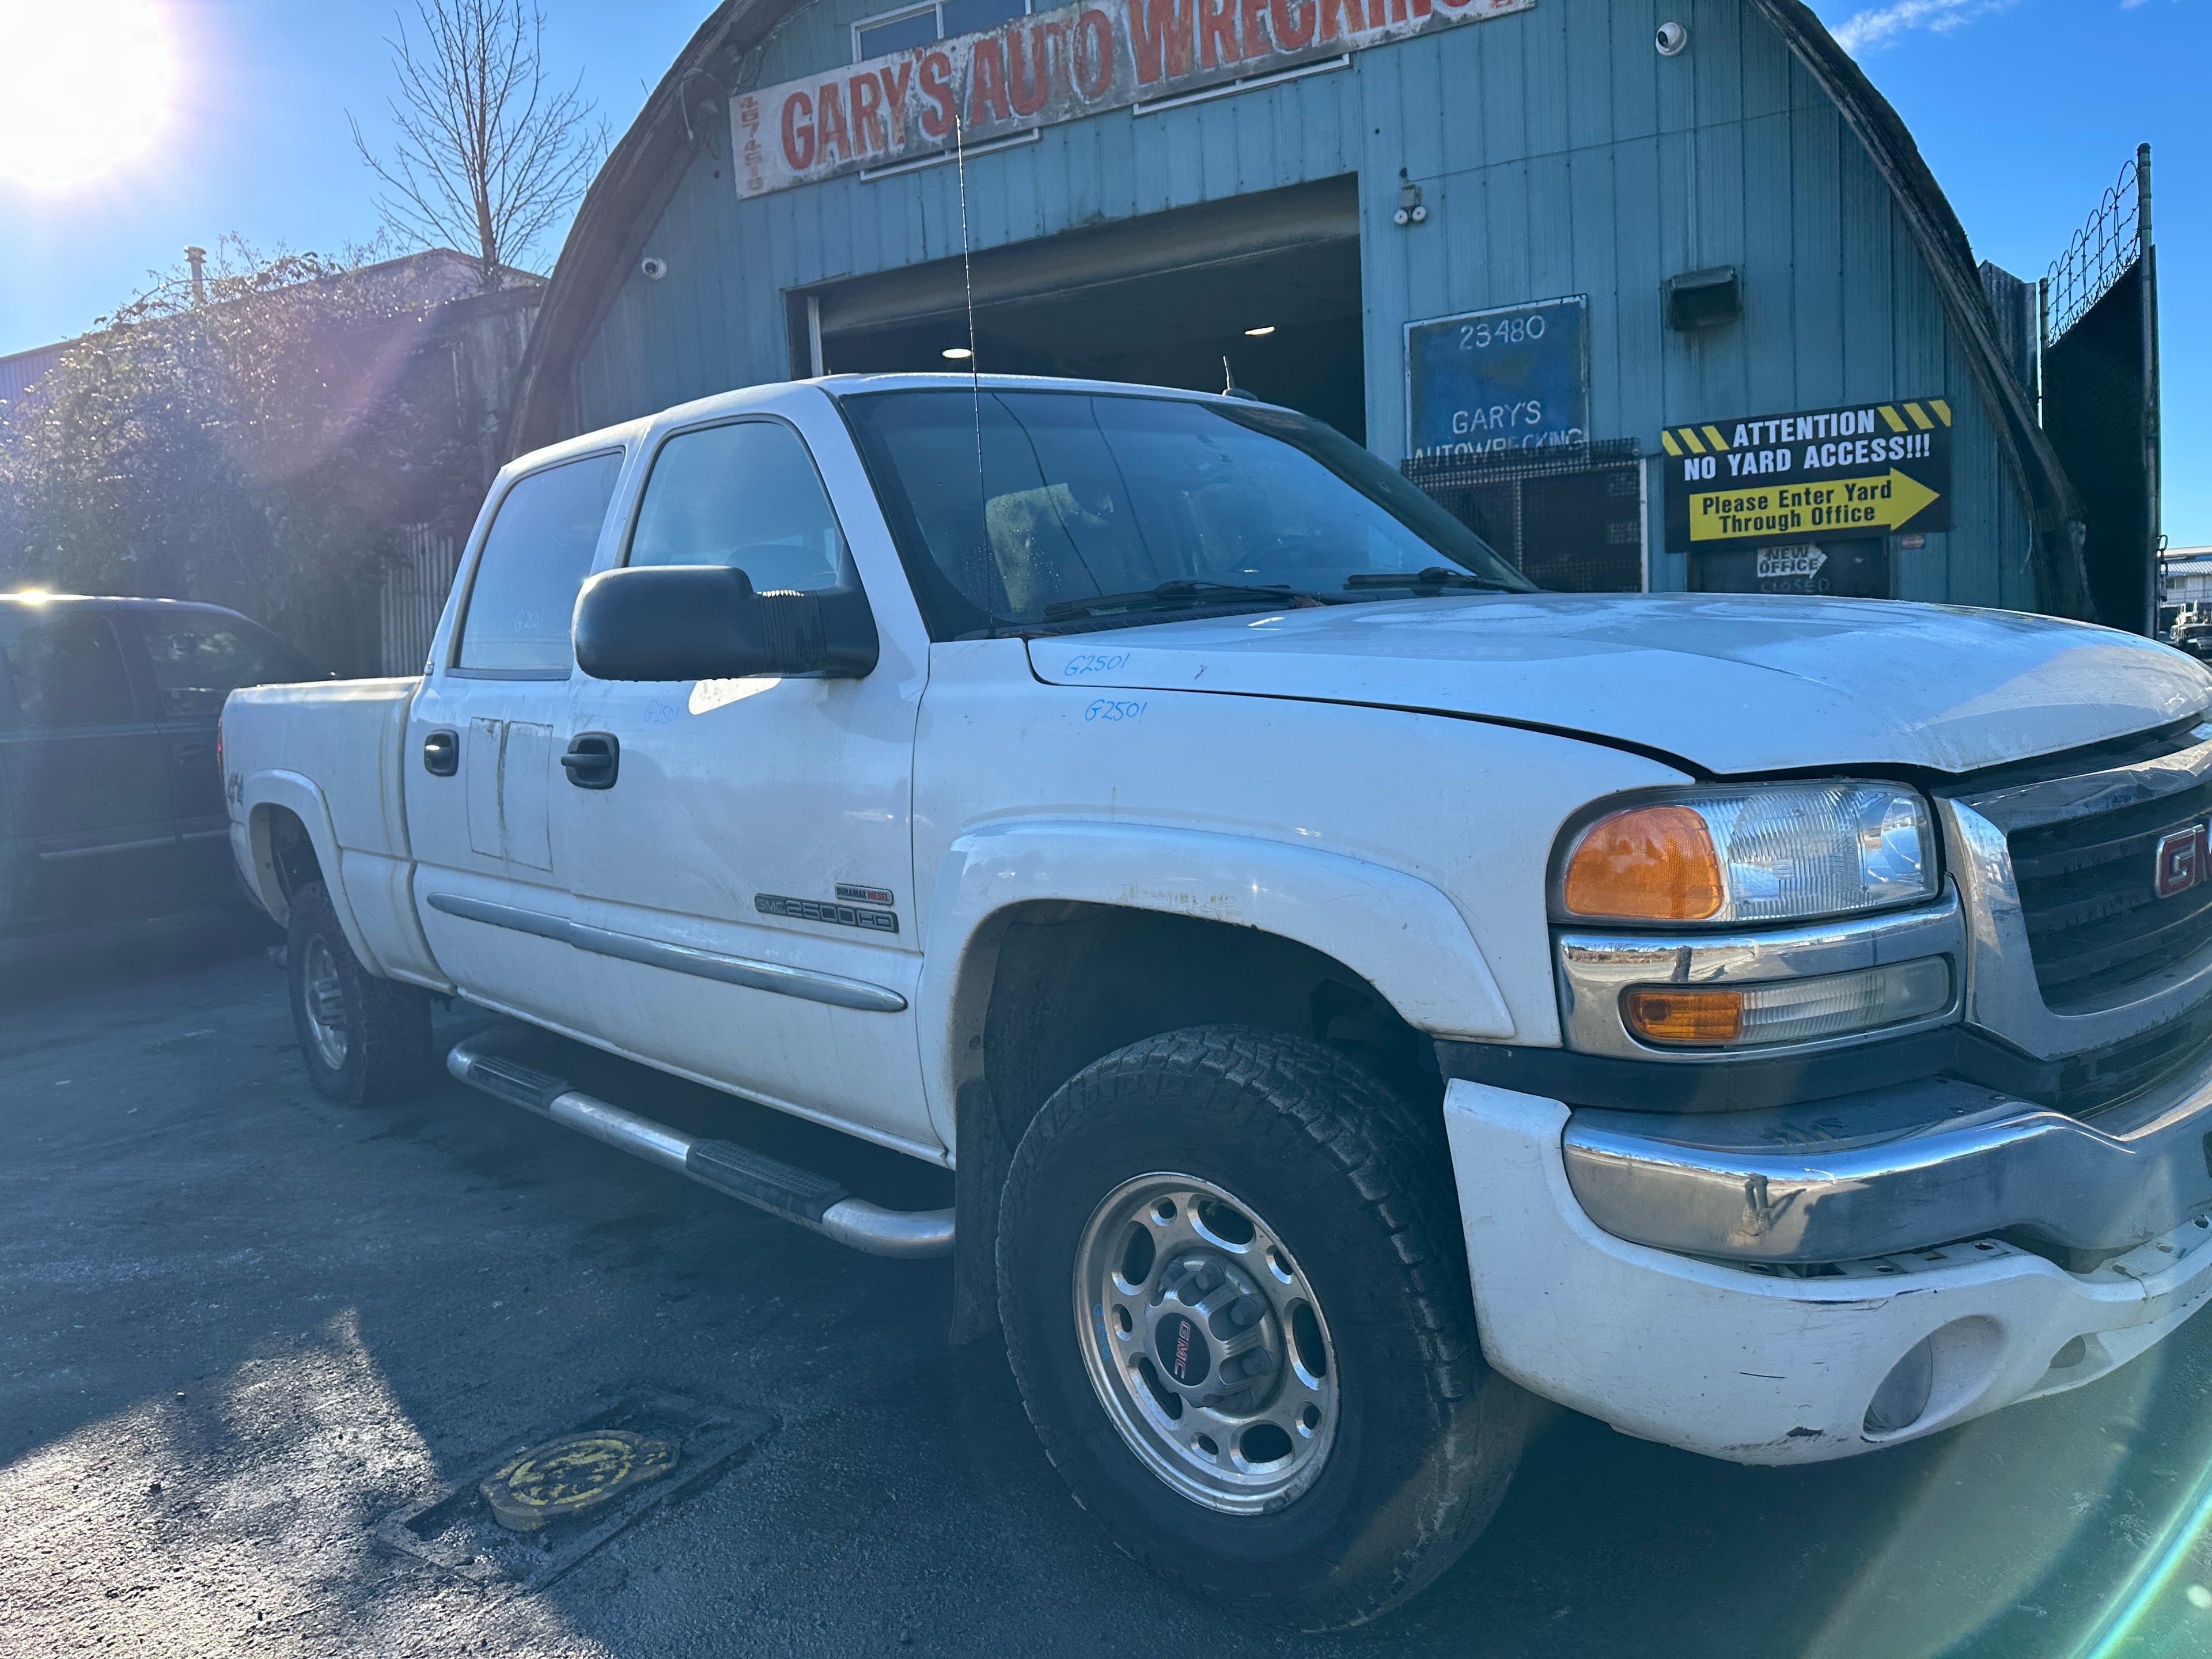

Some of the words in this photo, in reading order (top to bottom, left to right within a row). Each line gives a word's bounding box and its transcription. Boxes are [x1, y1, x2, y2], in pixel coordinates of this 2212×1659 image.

[782, 48, 953, 170] GARY'S
[970, 8, 1113, 125] AUTO
[1128, 0, 1514, 85] WREC
[1460, 315, 1546, 350] 23480
[1452, 400, 1541, 434] GARY'S
[1733, 408, 1874, 448] ATTENTION
[1684, 456, 1716, 481] NO
[1728, 448, 1791, 476] YARD
[1804, 433, 1931, 469] ACCESS!!!
[1702, 495, 1768, 515] Please
[1779, 488, 1834, 508] Enter
[1844, 480, 1892, 502] Yard
[1719, 509, 1801, 533] Through
[1811, 505, 1875, 525] Office
[1759, 558, 1819, 574] OFFICE
[1765, 547, 1809, 560] NEW
[1064, 653, 1130, 676] G2501
[1085, 699, 1147, 725] G2501
[836, 886, 867, 899] DURAMAX
[867, 891, 889, 902] DIESEL
[1174, 1320, 1191, 1380] GMC
